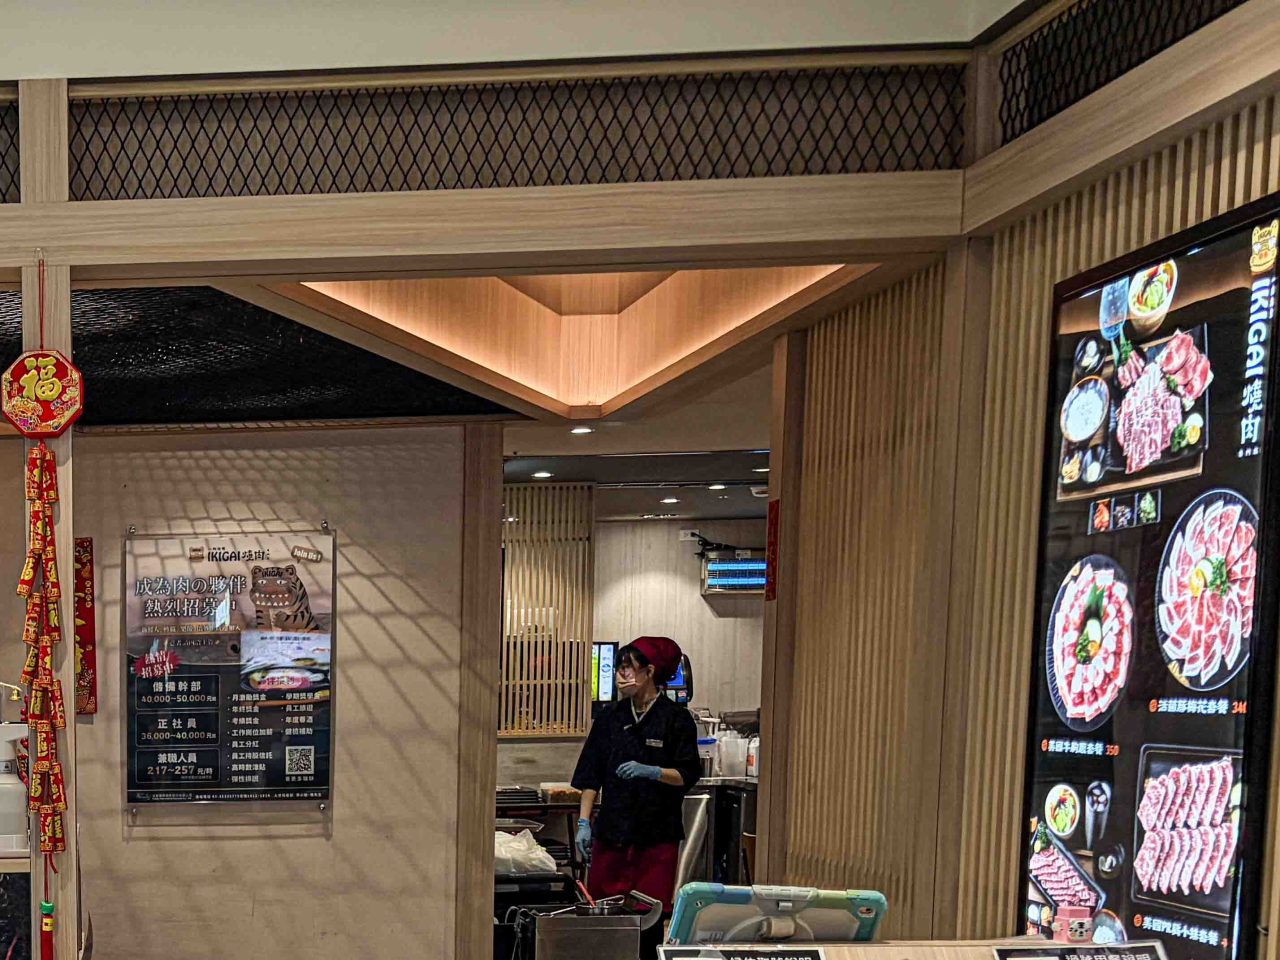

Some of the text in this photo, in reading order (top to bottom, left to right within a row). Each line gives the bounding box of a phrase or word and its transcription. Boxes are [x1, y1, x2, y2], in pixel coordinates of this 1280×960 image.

[20, 356, 61, 400] 福
[135, 575, 247, 596] 成為肉の夥伴
